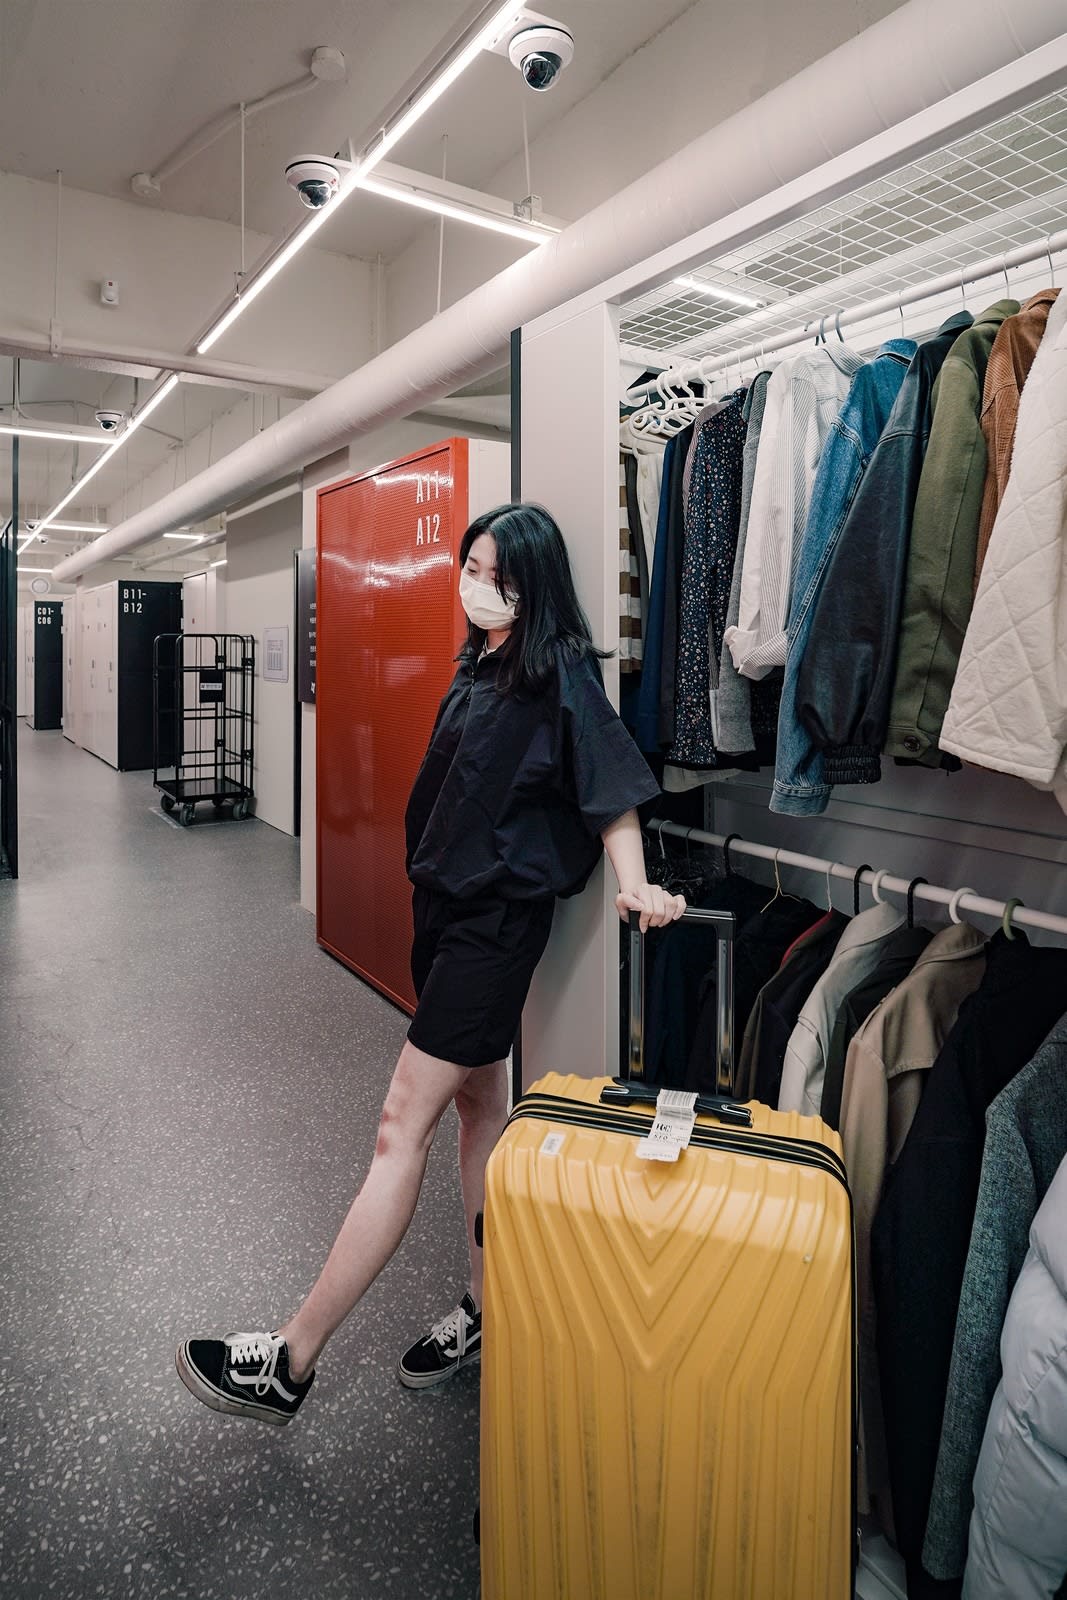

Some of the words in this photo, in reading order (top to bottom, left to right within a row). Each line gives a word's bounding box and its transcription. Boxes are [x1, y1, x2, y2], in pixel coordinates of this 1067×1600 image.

[416, 513, 440, 546] A12
[123, 588, 147, 599] B11-
[123, 602, 143, 613] B12
